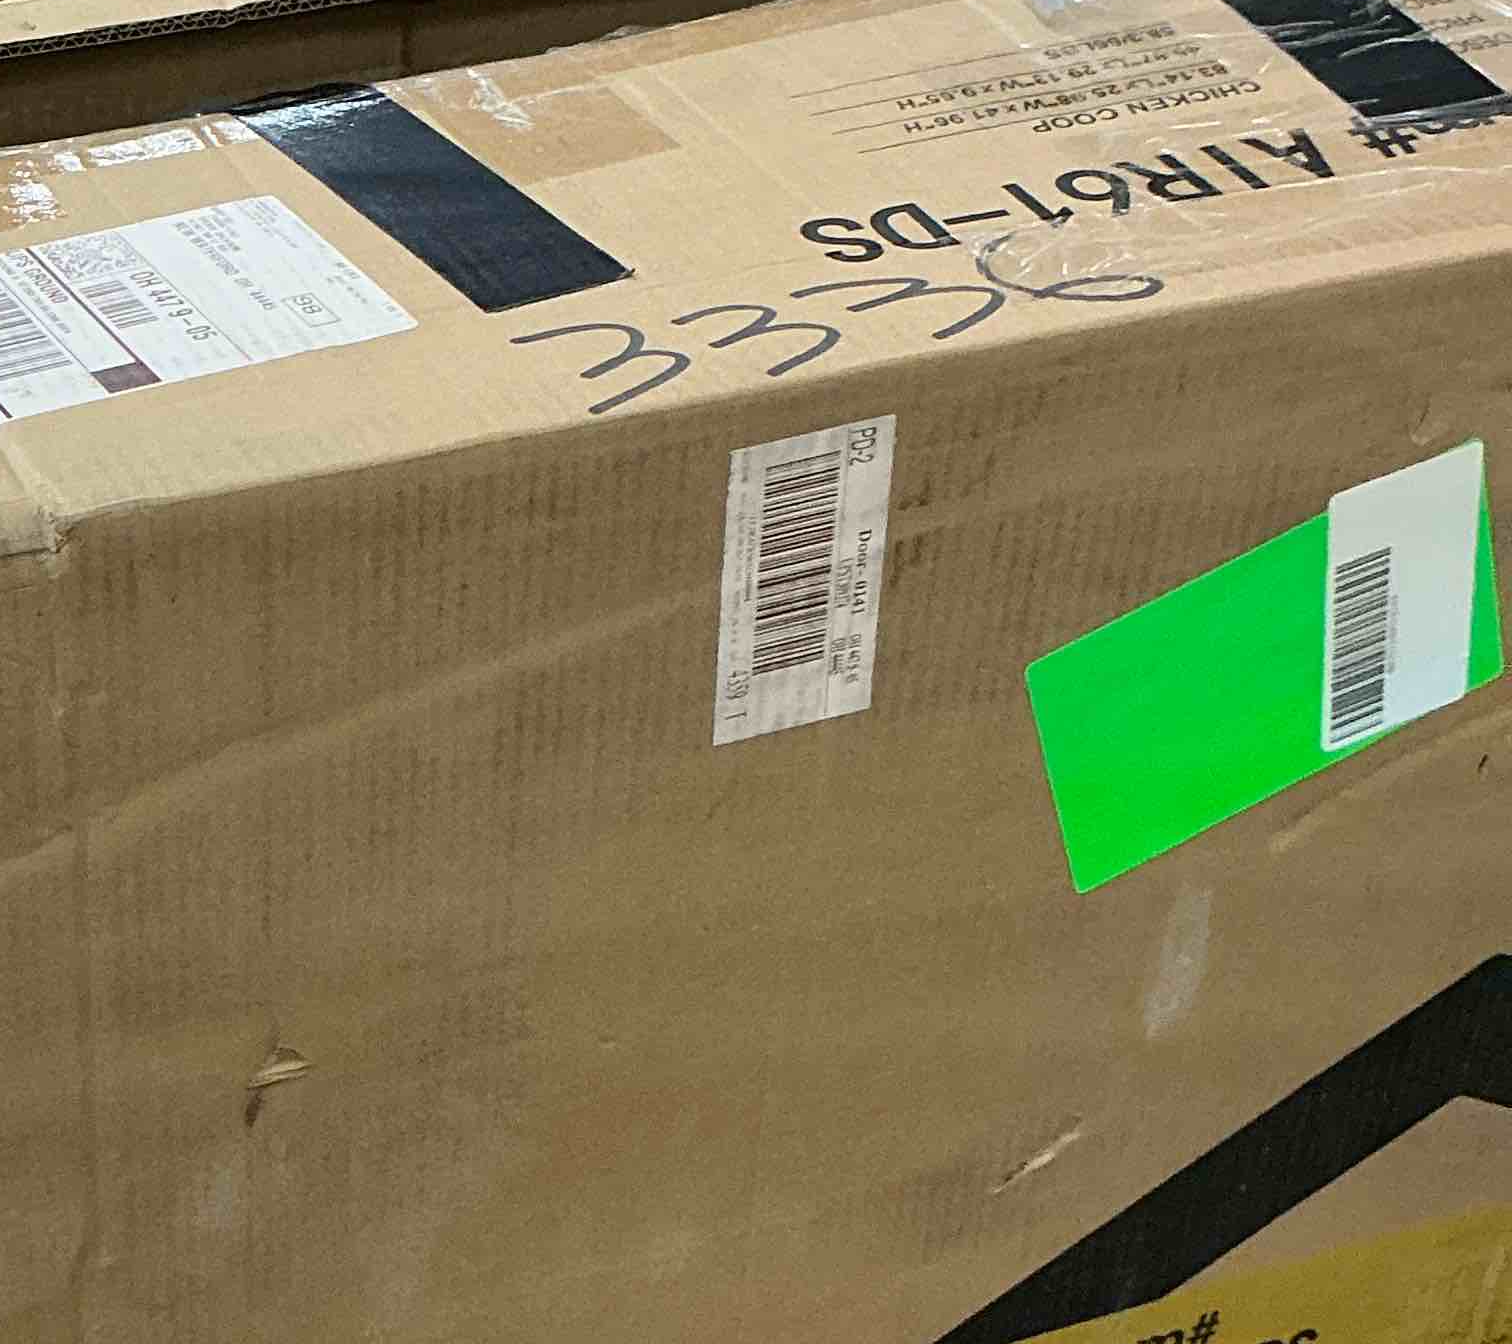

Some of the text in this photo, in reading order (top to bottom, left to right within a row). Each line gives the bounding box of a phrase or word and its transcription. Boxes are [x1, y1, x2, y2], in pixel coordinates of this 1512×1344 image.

[1032, 79, 1261, 135] CHICKEN COOP
[800, 129, 1336, 263] AIR61-DS
[128, 269, 153, 289] OH
